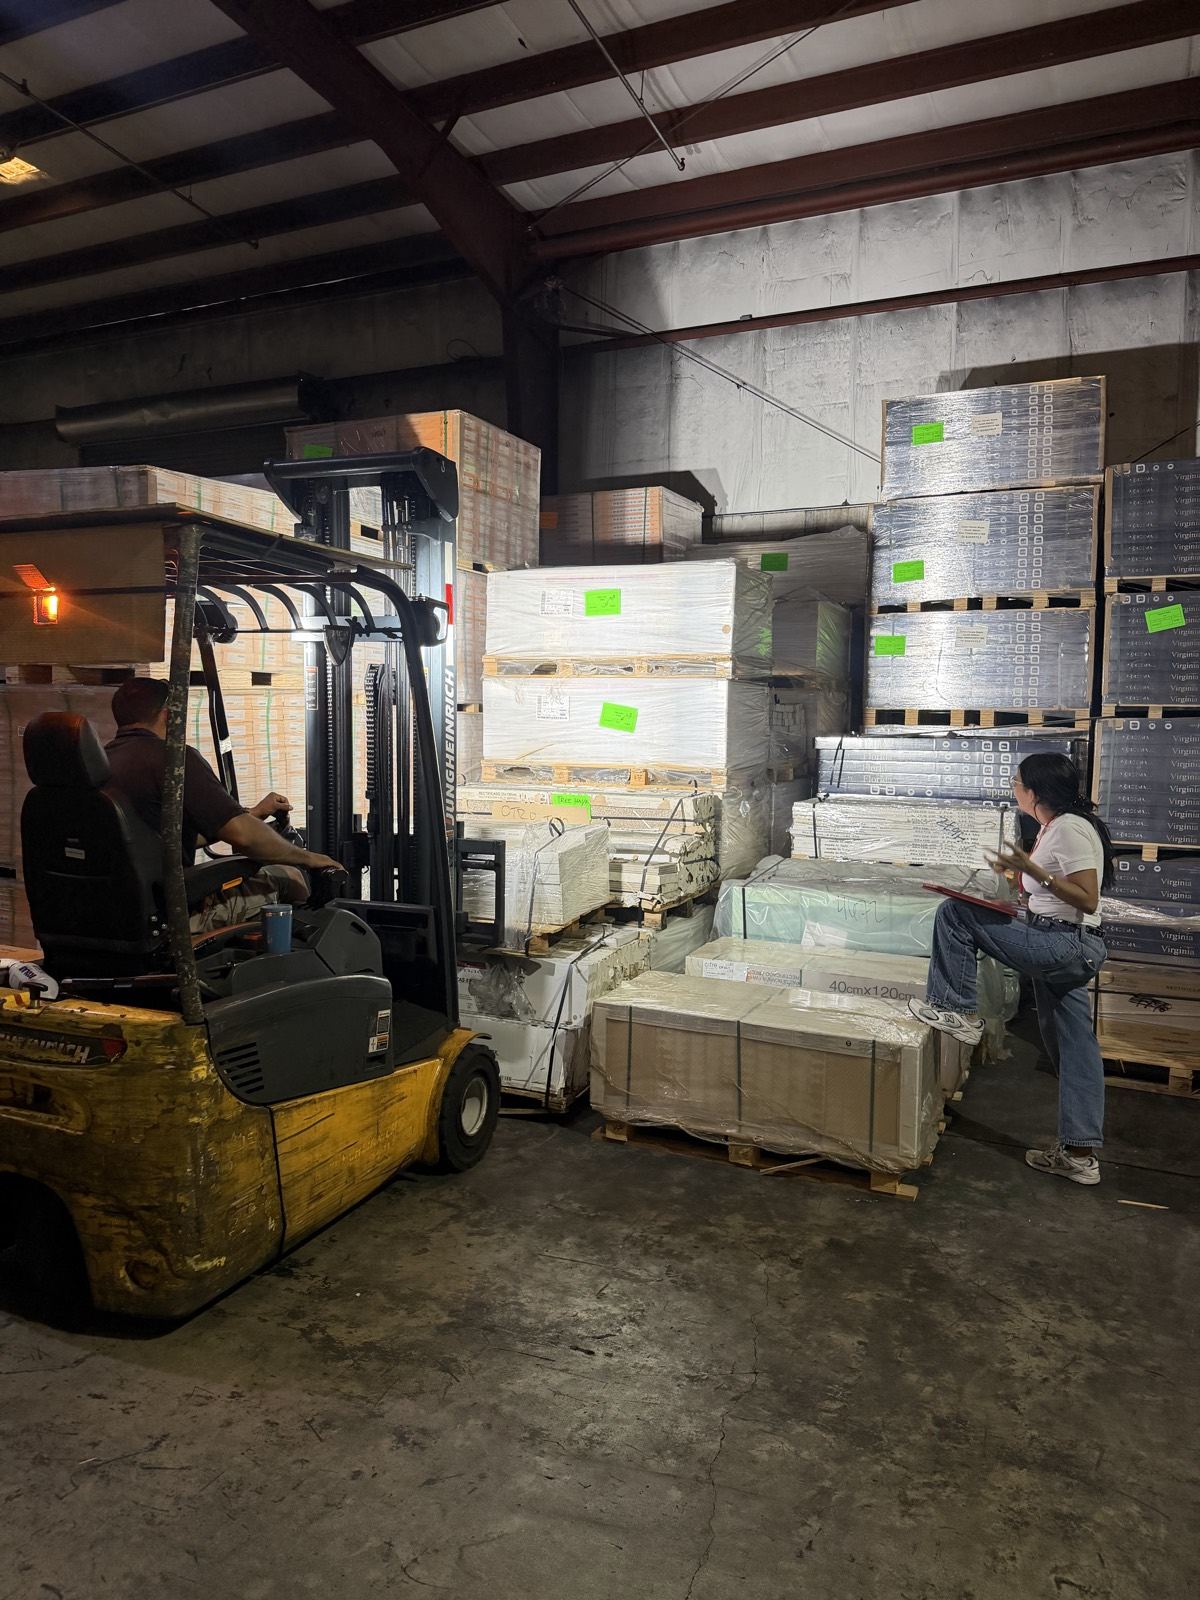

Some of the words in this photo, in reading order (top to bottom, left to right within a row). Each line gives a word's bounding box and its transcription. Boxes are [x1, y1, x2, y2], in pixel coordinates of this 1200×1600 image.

[444, 669, 456, 826] JUNGHEINRICH
[1160, 878, 1192, 888] Virginia
[1160, 890, 1192, 900] Virginia
[1160, 930, 1194, 942] Virginia
[1161, 945, 1195, 957] Virginia
[828, 979, 916, 1000] 40cmx120cm
